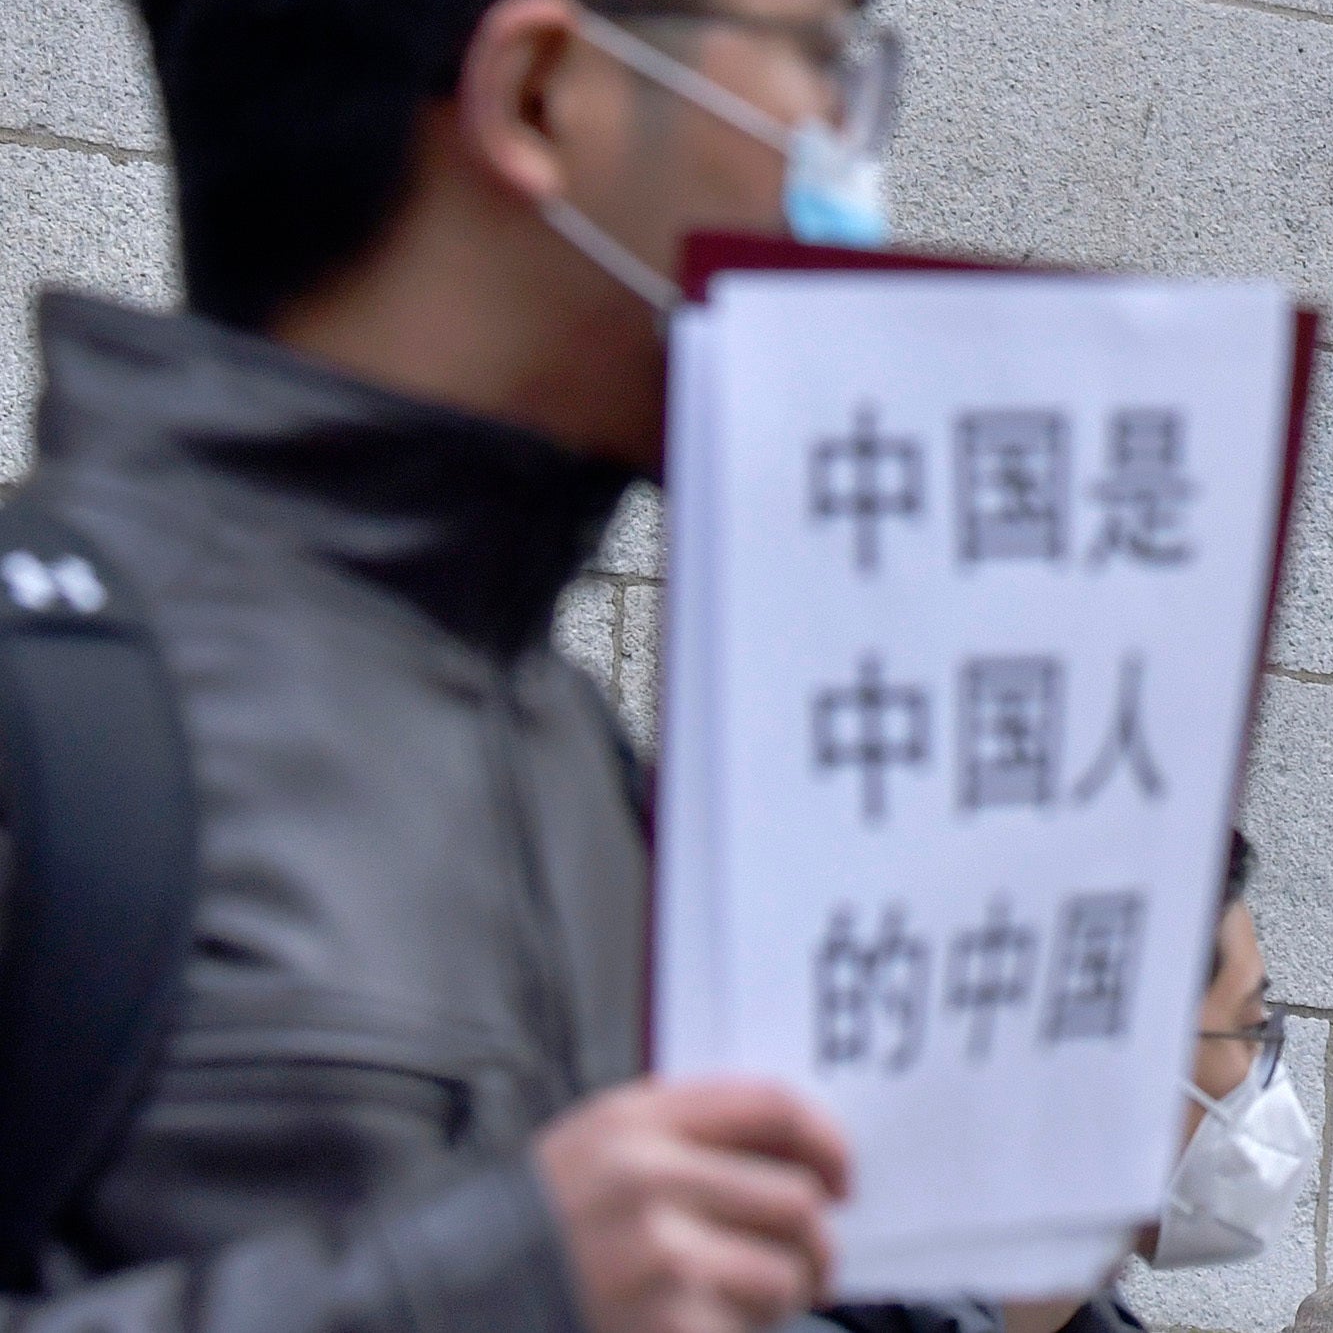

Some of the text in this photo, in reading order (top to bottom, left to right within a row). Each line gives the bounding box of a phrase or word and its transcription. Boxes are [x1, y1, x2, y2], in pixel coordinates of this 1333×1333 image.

[808, 404, 1200, 572] 中国是
[810, 654, 1166, 822] 中国人
[814, 892, 1148, 1070] 的中国
